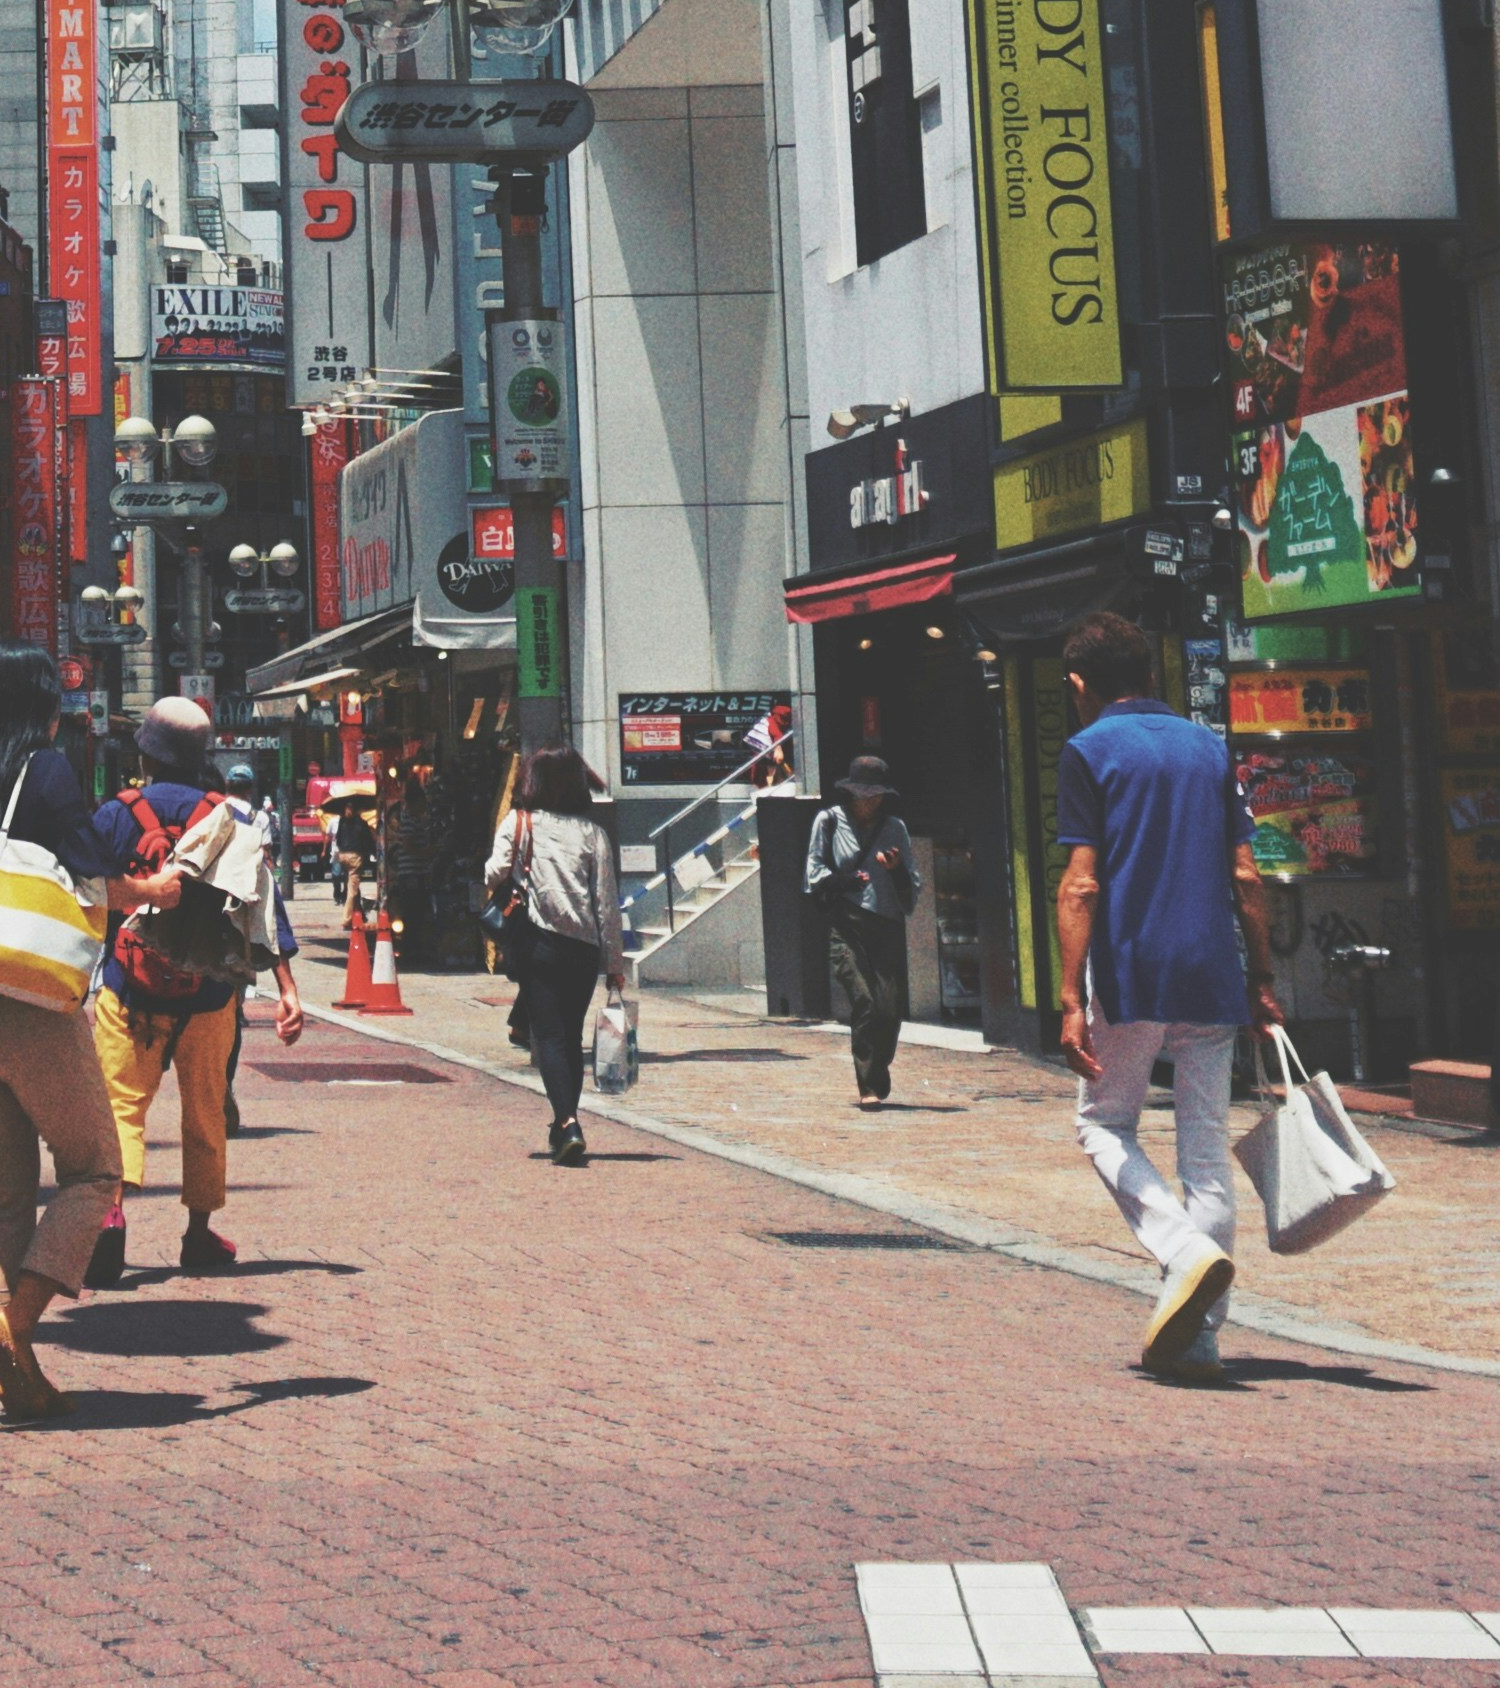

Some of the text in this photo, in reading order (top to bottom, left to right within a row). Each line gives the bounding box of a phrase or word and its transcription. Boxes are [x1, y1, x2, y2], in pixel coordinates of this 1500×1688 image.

[361, 98, 578, 130] 渋谷センター街
[996, 0, 1028, 220] inner collection
[1039, 104, 1104, 327] FOCUS
[156, 288, 247, 317] EXILE
[155, 337, 217, 356] 7.25
[314, 346, 349, 363] 渋谷
[307, 365, 357, 383] 2号店
[1235, 385, 1253, 416] 4F
[16, 382, 50, 518] カラオケ
[1240, 448, 1258, 476] 3F
[117, 488, 217, 510] 渋谷センター街
[1278, 477, 1340, 516] ガーデン
[1281, 513, 1333, 545] ファーム
[530, 593, 550, 689] 客引きは犯罪です
